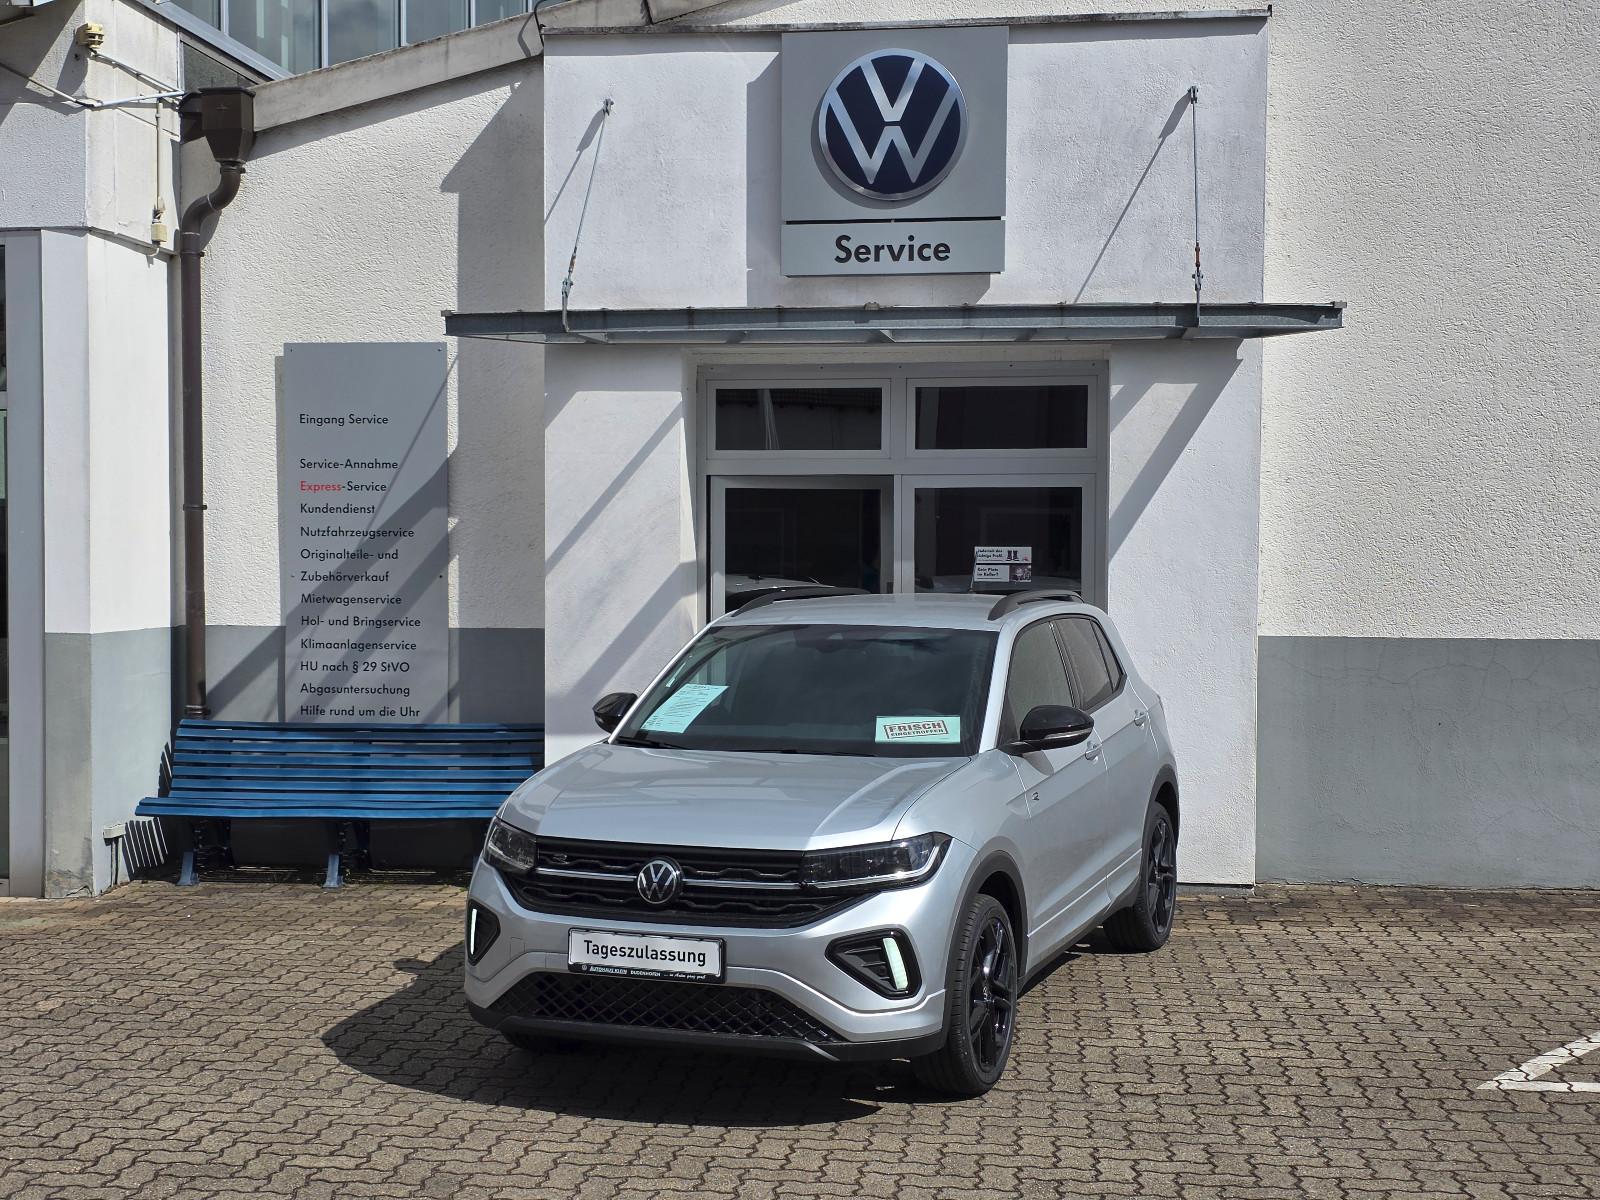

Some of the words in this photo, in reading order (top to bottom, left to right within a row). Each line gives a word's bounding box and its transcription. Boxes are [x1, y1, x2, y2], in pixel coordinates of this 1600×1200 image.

[834, 234, 951, 264] Service
[299, 413, 345, 427] Eingang
[348, 413, 389, 425] Service
[300, 458, 399, 470] Service-Annahme
[300, 480, 387, 494] Express-Service
[300, 503, 375, 514] Kundendienst
[300, 526, 415, 540] Nutzfahrzeugservice
[300, 548, 374, 561] Originalteile-
[378, 548, 399, 560] und
[300, 571, 390, 582] Zubehörverkauf
[300, 593, 403, 606] Mietwagenservice
[301, 616, 325, 626] Hol-
[328, 616, 349, 626] und
[353, 616, 421, 629] Bringservice
[300, 638, 417, 652] Klimaanlagenservice
[300, 661, 318, 671] HU
[322, 661, 349, 672] nach
[352, 661, 359, 674] §
[362, 661, 377, 672] 29
[380, 661, 410, 673] StVO
[300, 683, 410, 697] Abgasuntersuchung
[300, 705, 326, 716] Hilfe
[330, 705, 355, 717] rund
[358, 707, 375, 717] um
[379, 705, 396, 717] die
[400, 706, 420, 717] Uhr
[889, 722, 942, 733] FRISCH
[583, 939, 706, 967] Tageszulassung
